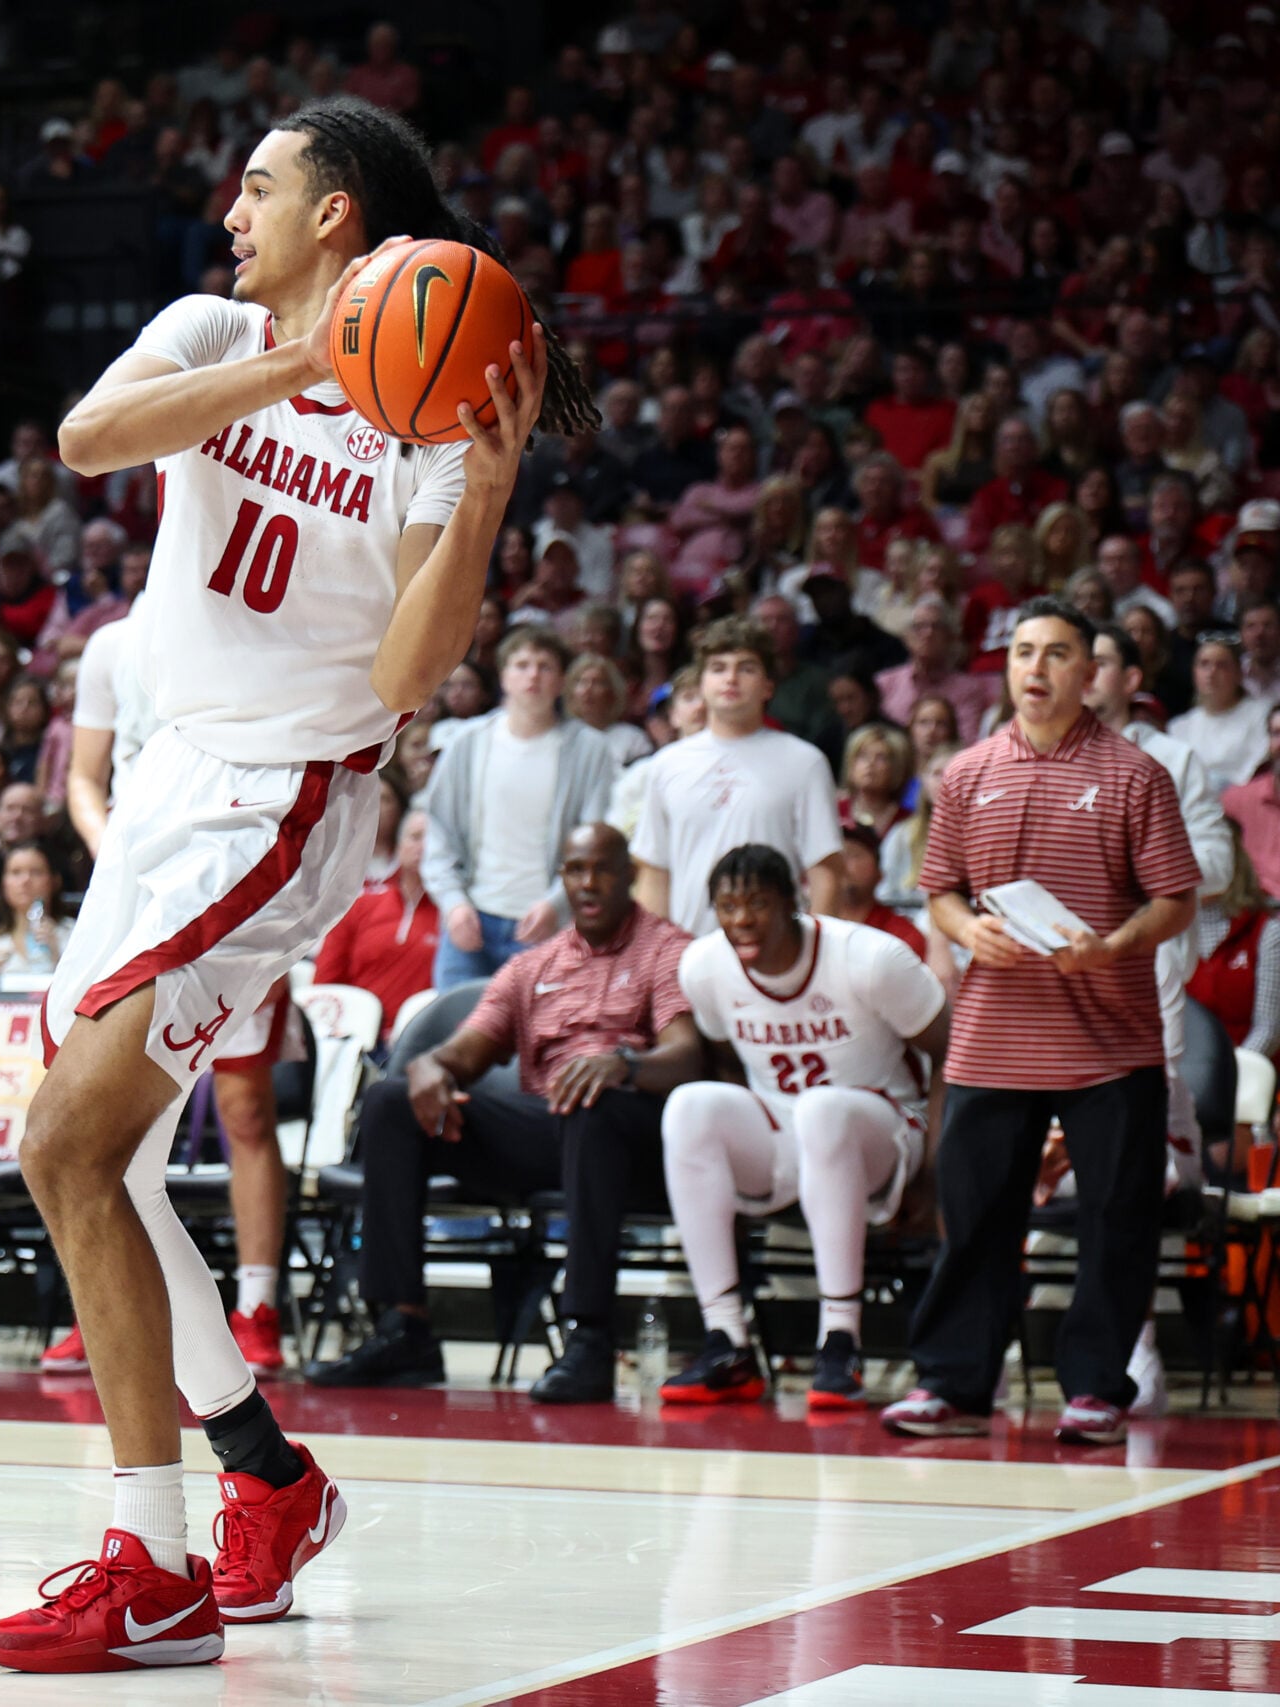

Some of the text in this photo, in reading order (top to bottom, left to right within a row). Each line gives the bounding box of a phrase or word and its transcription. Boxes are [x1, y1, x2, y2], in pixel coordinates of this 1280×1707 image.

[349, 427, 384, 459] SEC
[201, 424, 374, 523] ALABAMA
[208, 498, 299, 614] 10
[736, 1017, 851, 1045] ALABAMA
[770, 1052, 831, 1094] 22
